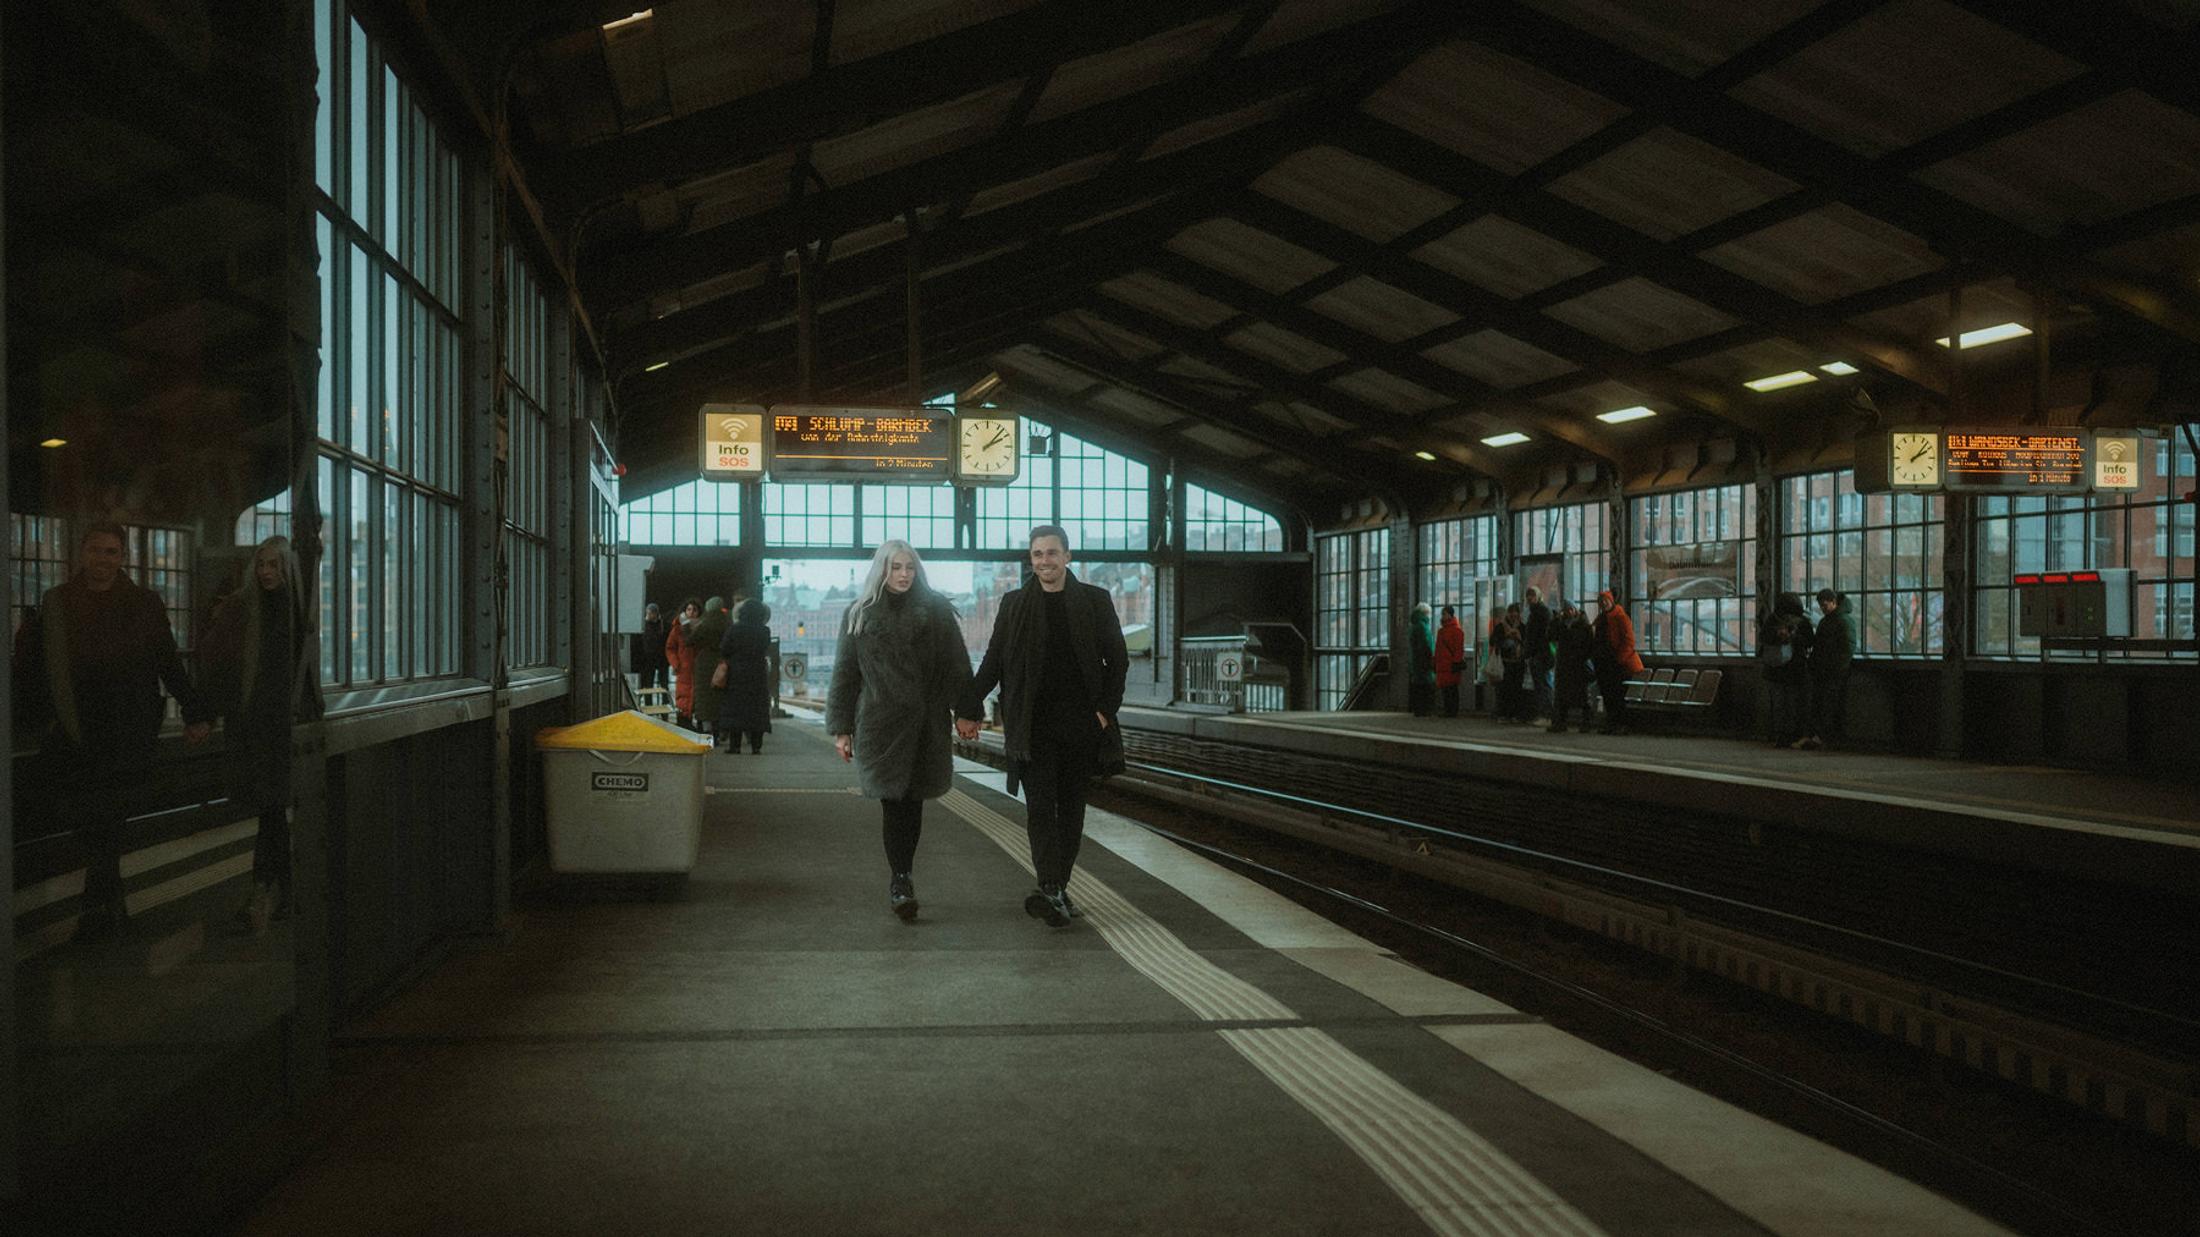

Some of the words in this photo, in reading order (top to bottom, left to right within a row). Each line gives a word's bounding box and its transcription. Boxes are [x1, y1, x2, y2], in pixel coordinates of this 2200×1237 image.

[719, 444, 749, 455] Info
[719, 456, 749, 467] SOS
[2103, 464, 2127, 474] Info
[2103, 475, 2127, 484] SOS
[597, 777, 643, 786] CHEMO
